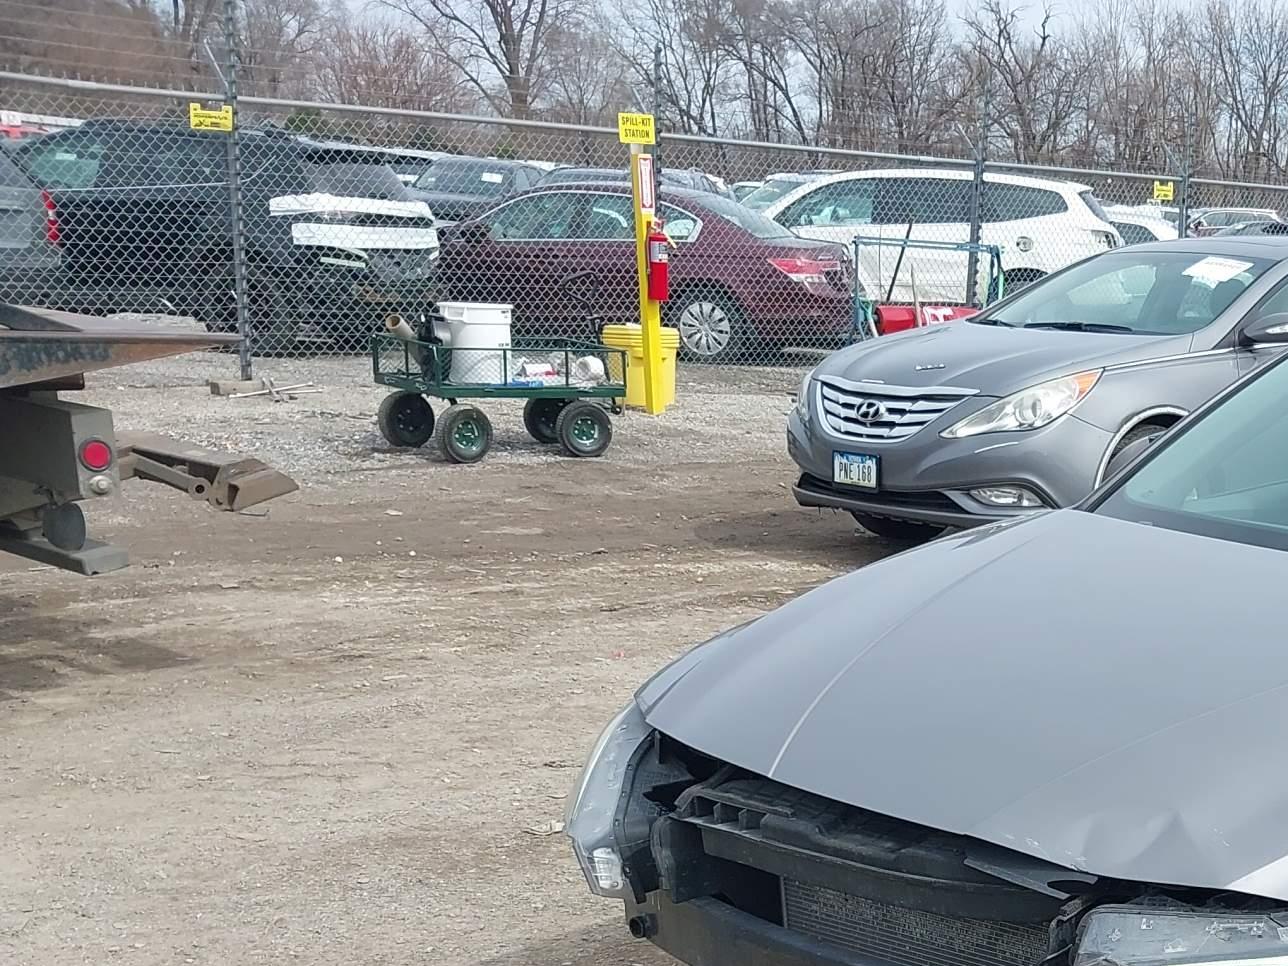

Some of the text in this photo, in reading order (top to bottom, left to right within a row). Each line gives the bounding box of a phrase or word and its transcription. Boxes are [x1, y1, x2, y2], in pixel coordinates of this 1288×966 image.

[621, 116, 651, 127] SPILL-KIT
[624, 128, 650, 138] STATION
[838, 461, 872, 483] PNE 168
